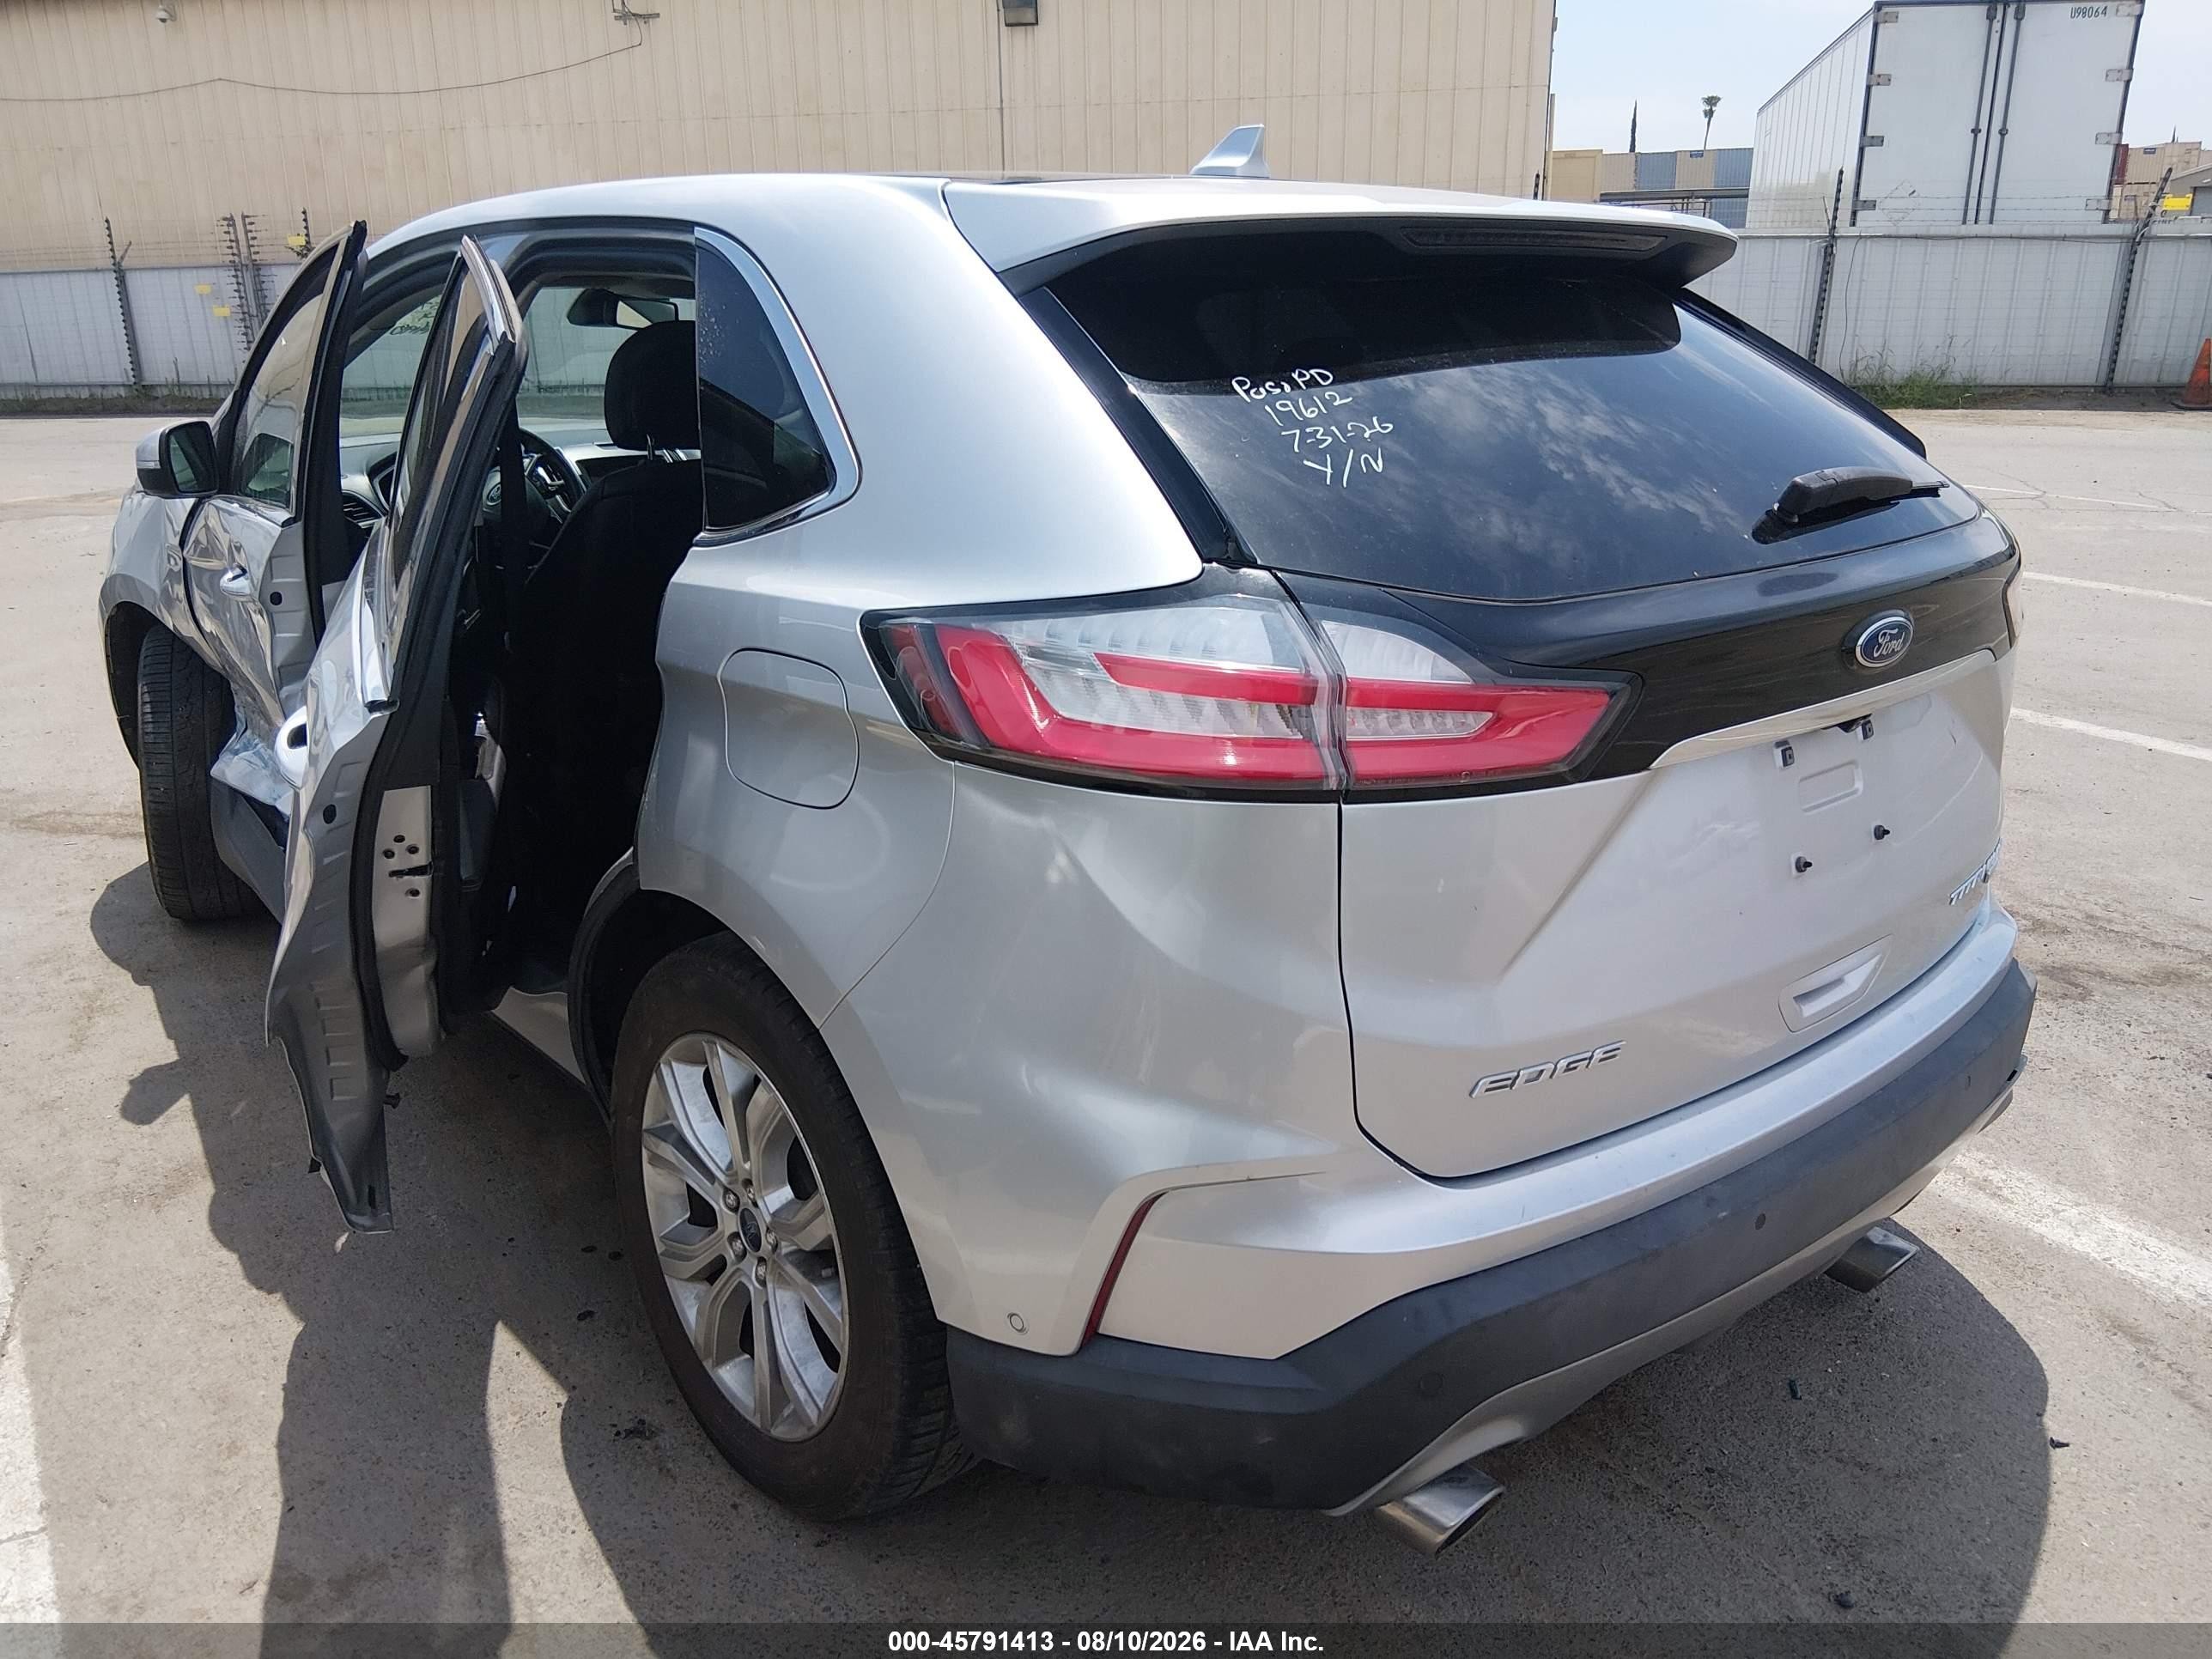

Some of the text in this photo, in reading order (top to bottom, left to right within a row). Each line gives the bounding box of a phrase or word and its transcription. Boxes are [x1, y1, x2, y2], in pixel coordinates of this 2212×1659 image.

[2070, 5, 2108, 19] U98064
[1265, 392, 1352, 427] 19612
[1281, 416, 1394, 453] 7-31-26
[1303, 447, 1384, 489] Y/N
[1874, 628, 1905, 658] Ford
[1469, 1040, 1627, 1099] EDGE
